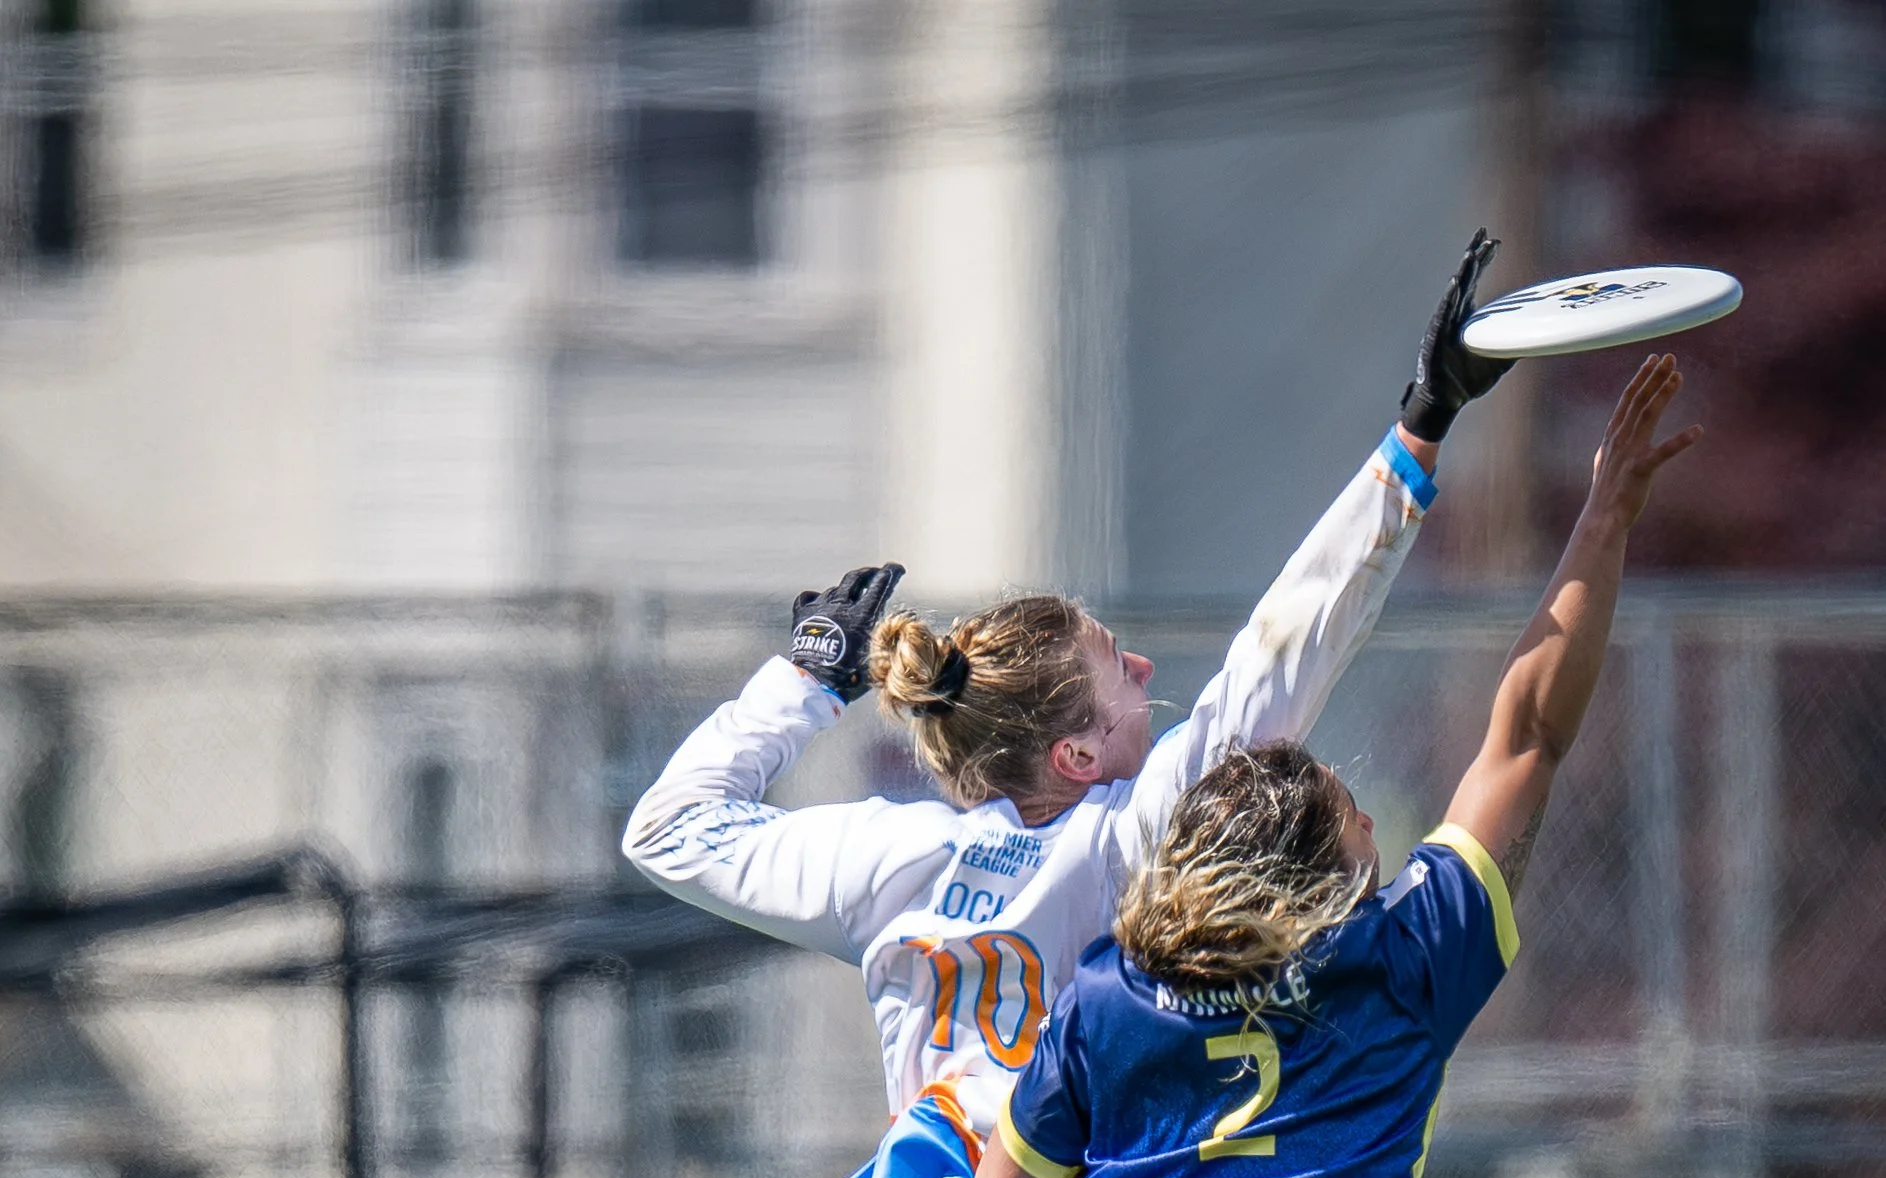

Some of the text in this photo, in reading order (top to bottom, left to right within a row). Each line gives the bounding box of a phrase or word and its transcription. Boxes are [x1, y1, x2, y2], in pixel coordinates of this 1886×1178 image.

[791, 635, 840, 655] STRIKE
[961, 850, 1021, 878] LEAGUE
[899, 929, 1049, 1072] 10
[1199, 1031, 1281, 1162] 2
